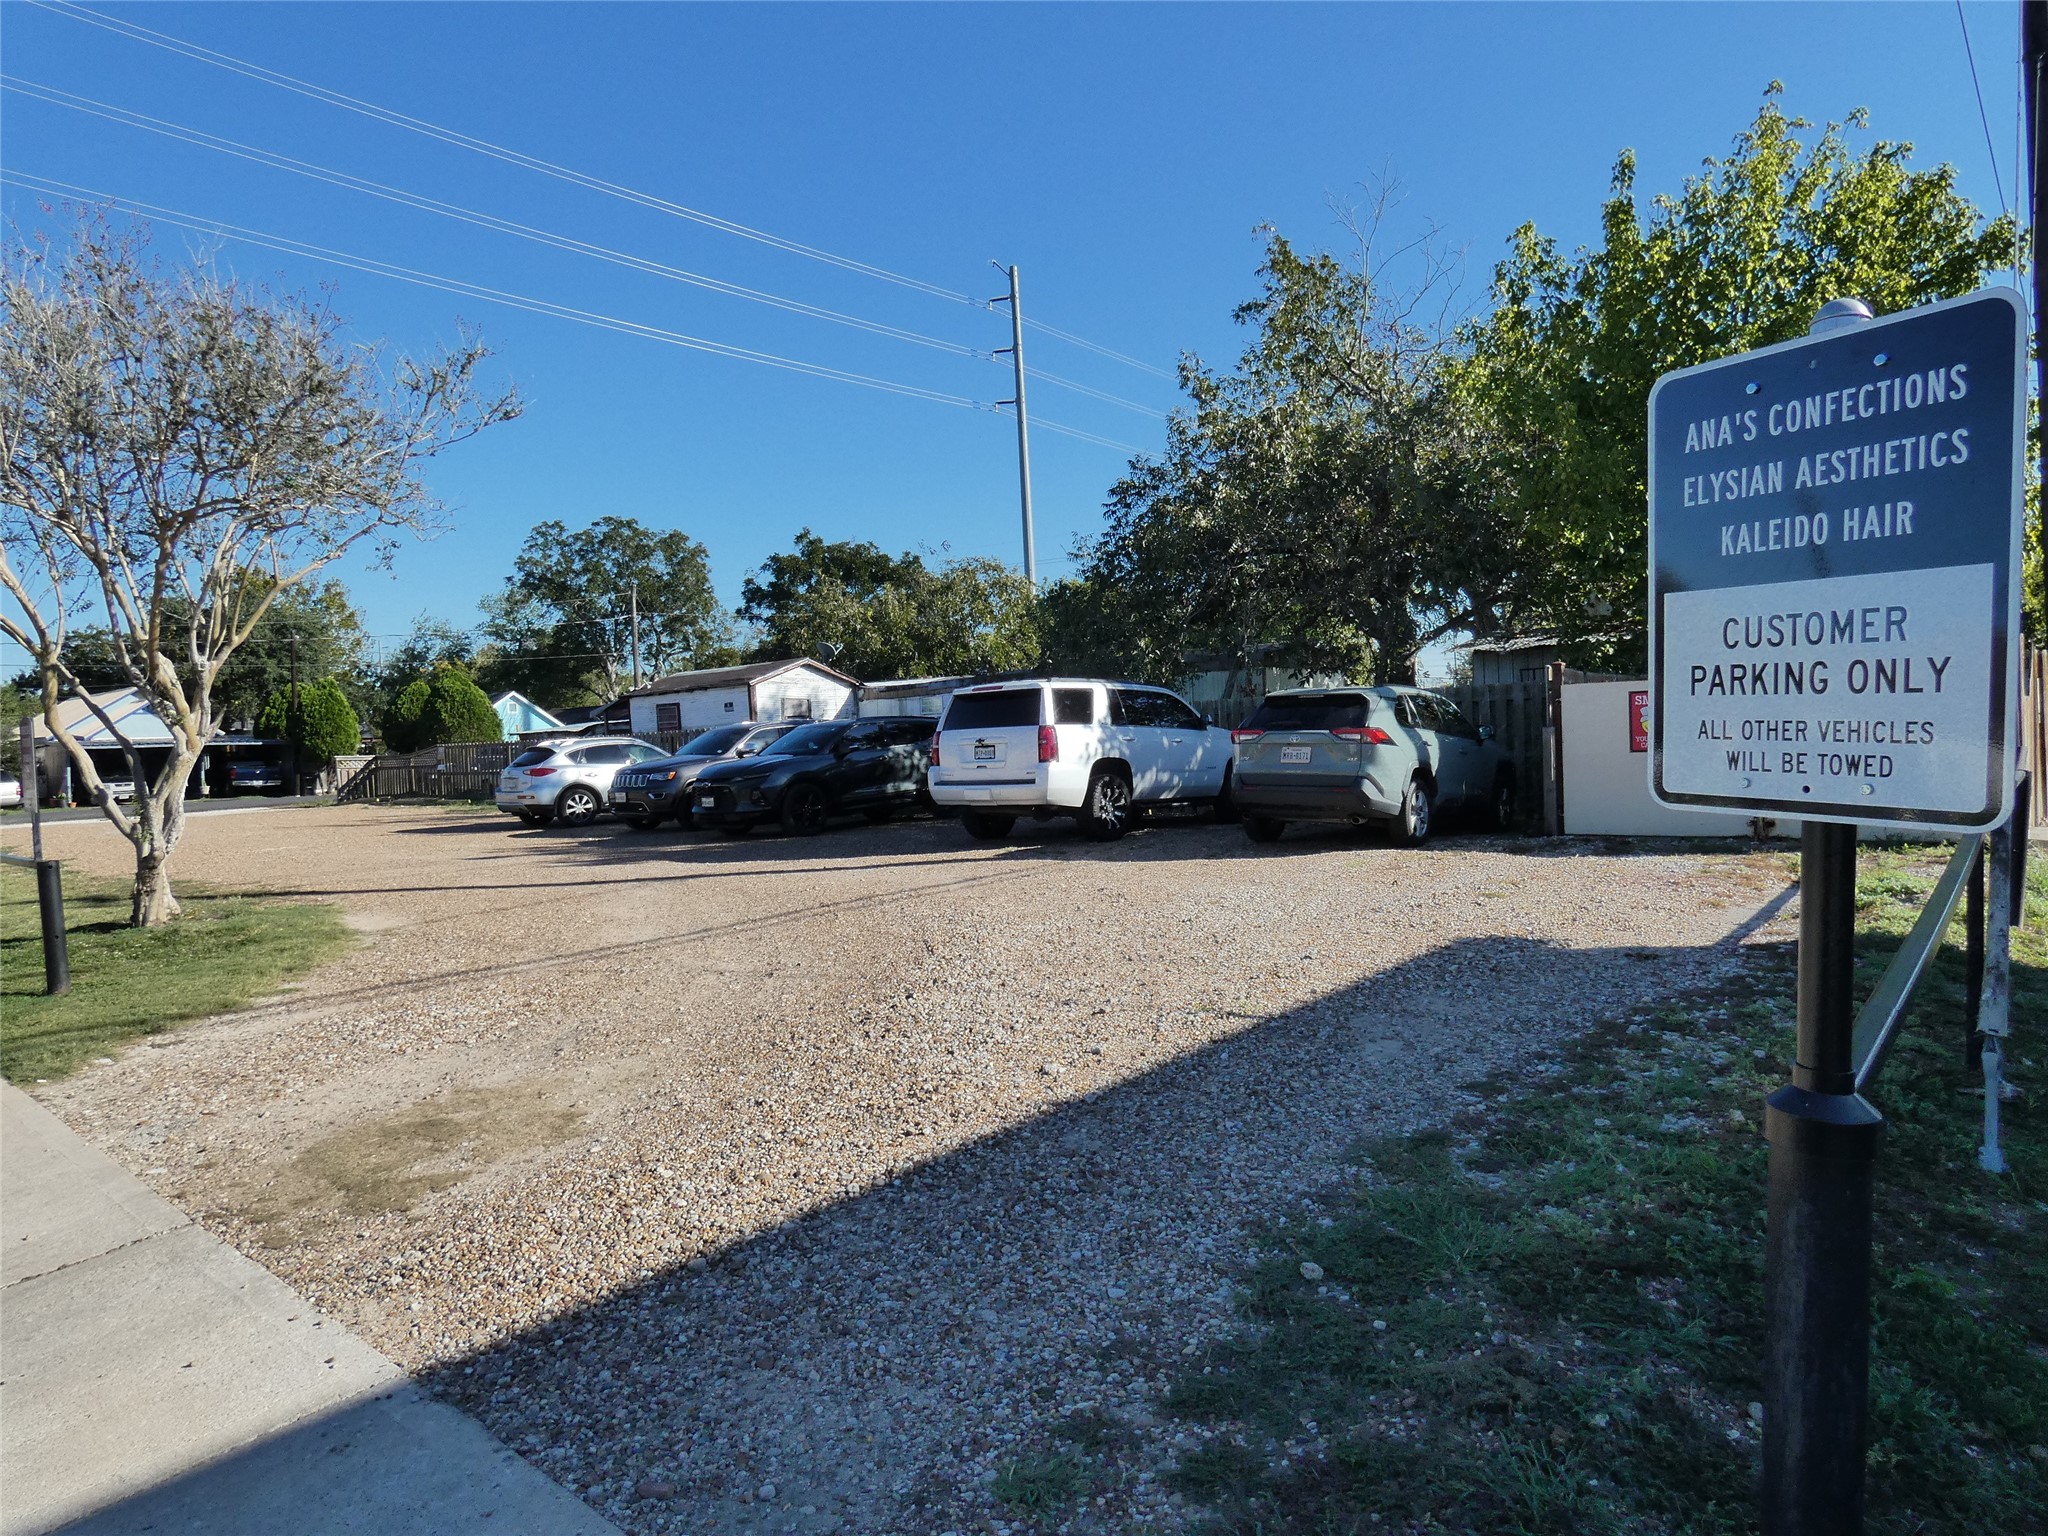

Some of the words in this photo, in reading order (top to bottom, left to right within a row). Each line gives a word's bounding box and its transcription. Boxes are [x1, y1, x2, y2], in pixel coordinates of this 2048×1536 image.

[1684, 409, 1758, 454] ANA'S
[1768, 363, 1968, 436] CONFECTIONS
[1683, 460, 1783, 507] ELYSIAN
[1794, 428, 1969, 490] AESTHETICS
[1721, 512, 1829, 556] KALEIDO
[1843, 501, 1913, 542] HAIR
[1722, 606, 1908, 649] CUSTOMER
[1690, 660, 1829, 696] PARKING
[1847, 656, 1952, 695] ONLY
[1697, 719, 1733, 741] ALL
[1741, 719, 1809, 743] OTHER
[1816, 720, 1935, 745] VEHICLES
[1726, 750, 1772, 773] WILL
[1781, 752, 1808, 774] BE
[1816, 754, 1894, 778] TOWED
